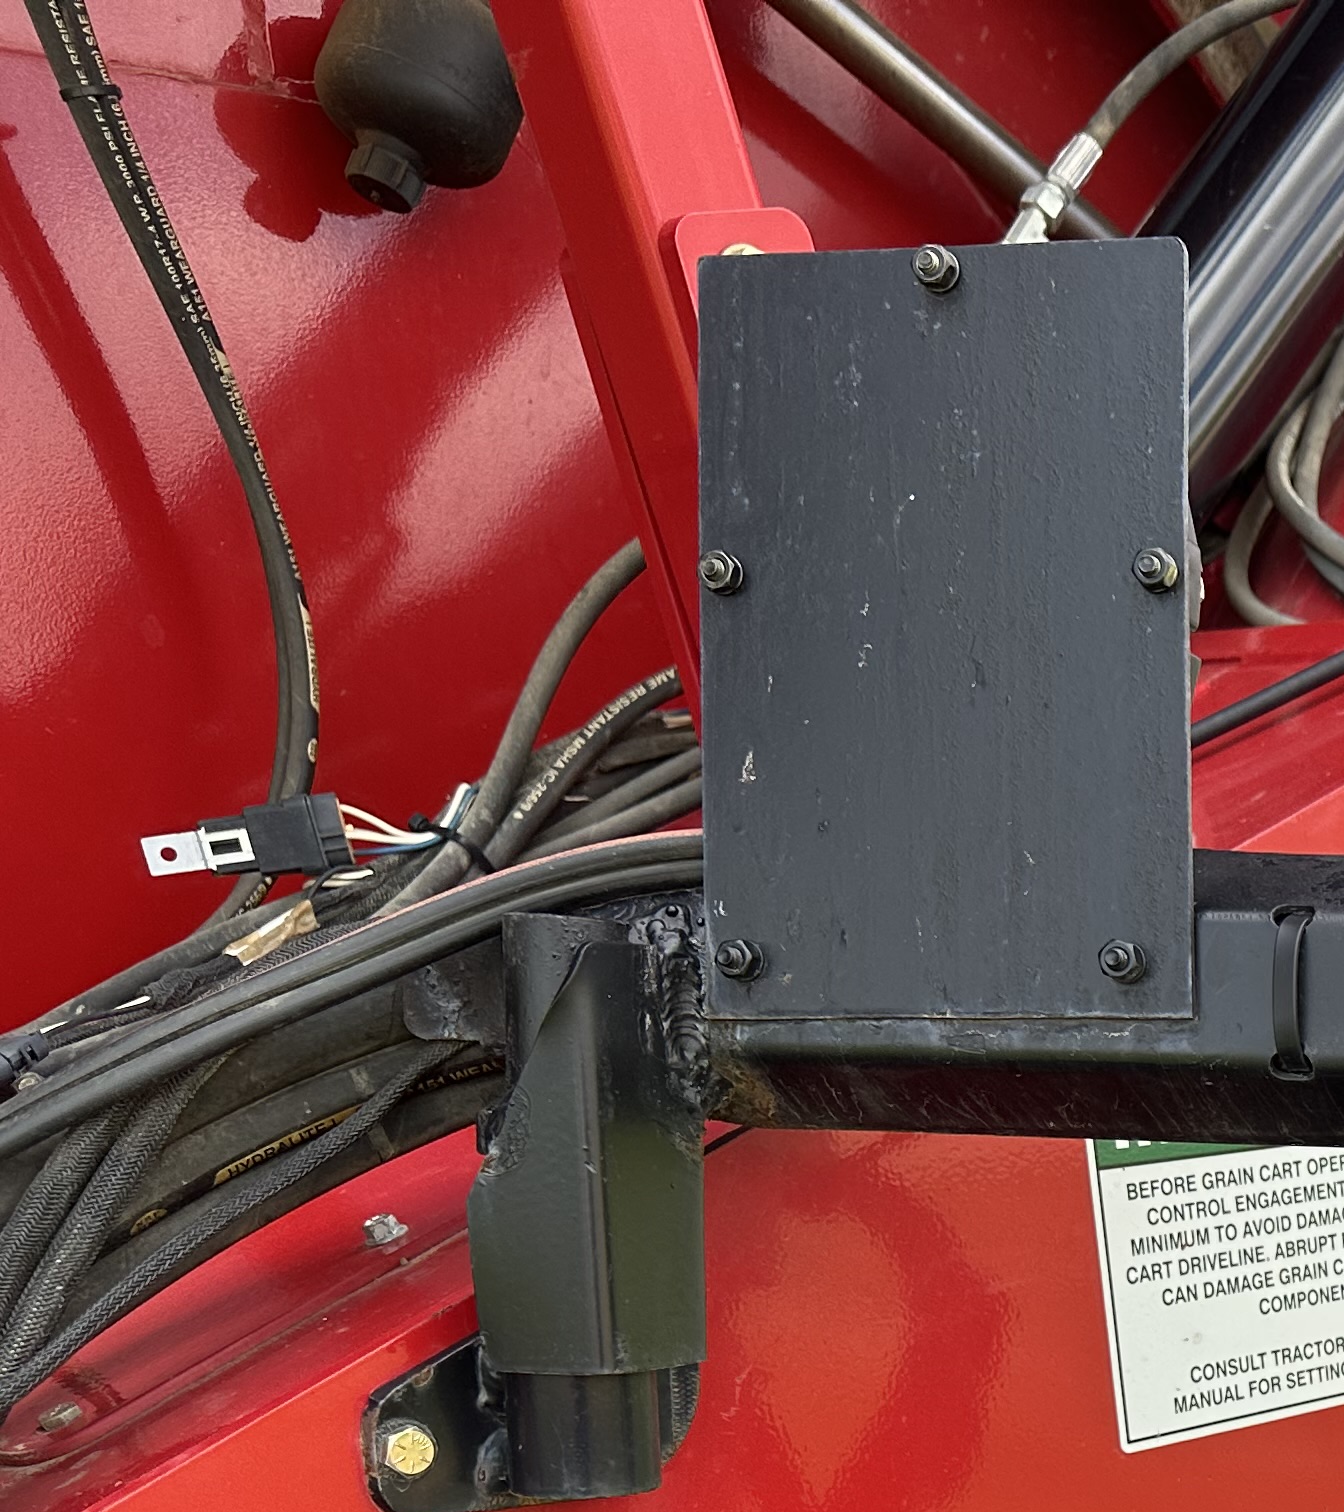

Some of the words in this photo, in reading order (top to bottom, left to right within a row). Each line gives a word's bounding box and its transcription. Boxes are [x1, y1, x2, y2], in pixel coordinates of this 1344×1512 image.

[48, 0, 81, 65] RESISTA
[583, 683, 648, 740] RESISTANT
[647, 668, 676, 691] AME
[1126, 1175, 1198, 1201] BEFORE
[1201, 1169, 1255, 1190] GRAIN
[1259, 1163, 1302, 1184] CART
[1130, 1228, 1210, 1257] MINIMUM
[1214, 1223, 1238, 1243] TO
[1242, 1213, 1292, 1239] AVOID
[1147, 1200, 1231, 1226] CONTROL
[1126, 1261, 1173, 1285] CART
[1178, 1244, 1270, 1277] DRIVELINE.
[1274, 1234, 1337, 1260] ABRUPT
[1161, 1284, 1198, 1306] CAN
[1203, 1272, 1275, 1300] DAMAGE
[1278, 1262, 1329, 1286] GRAIN
[1190, 1353, 1268, 1385] CONSULT
[1173, 1383, 1245, 1415] MANUAL
[1249, 1374, 1282, 1399] FOR
